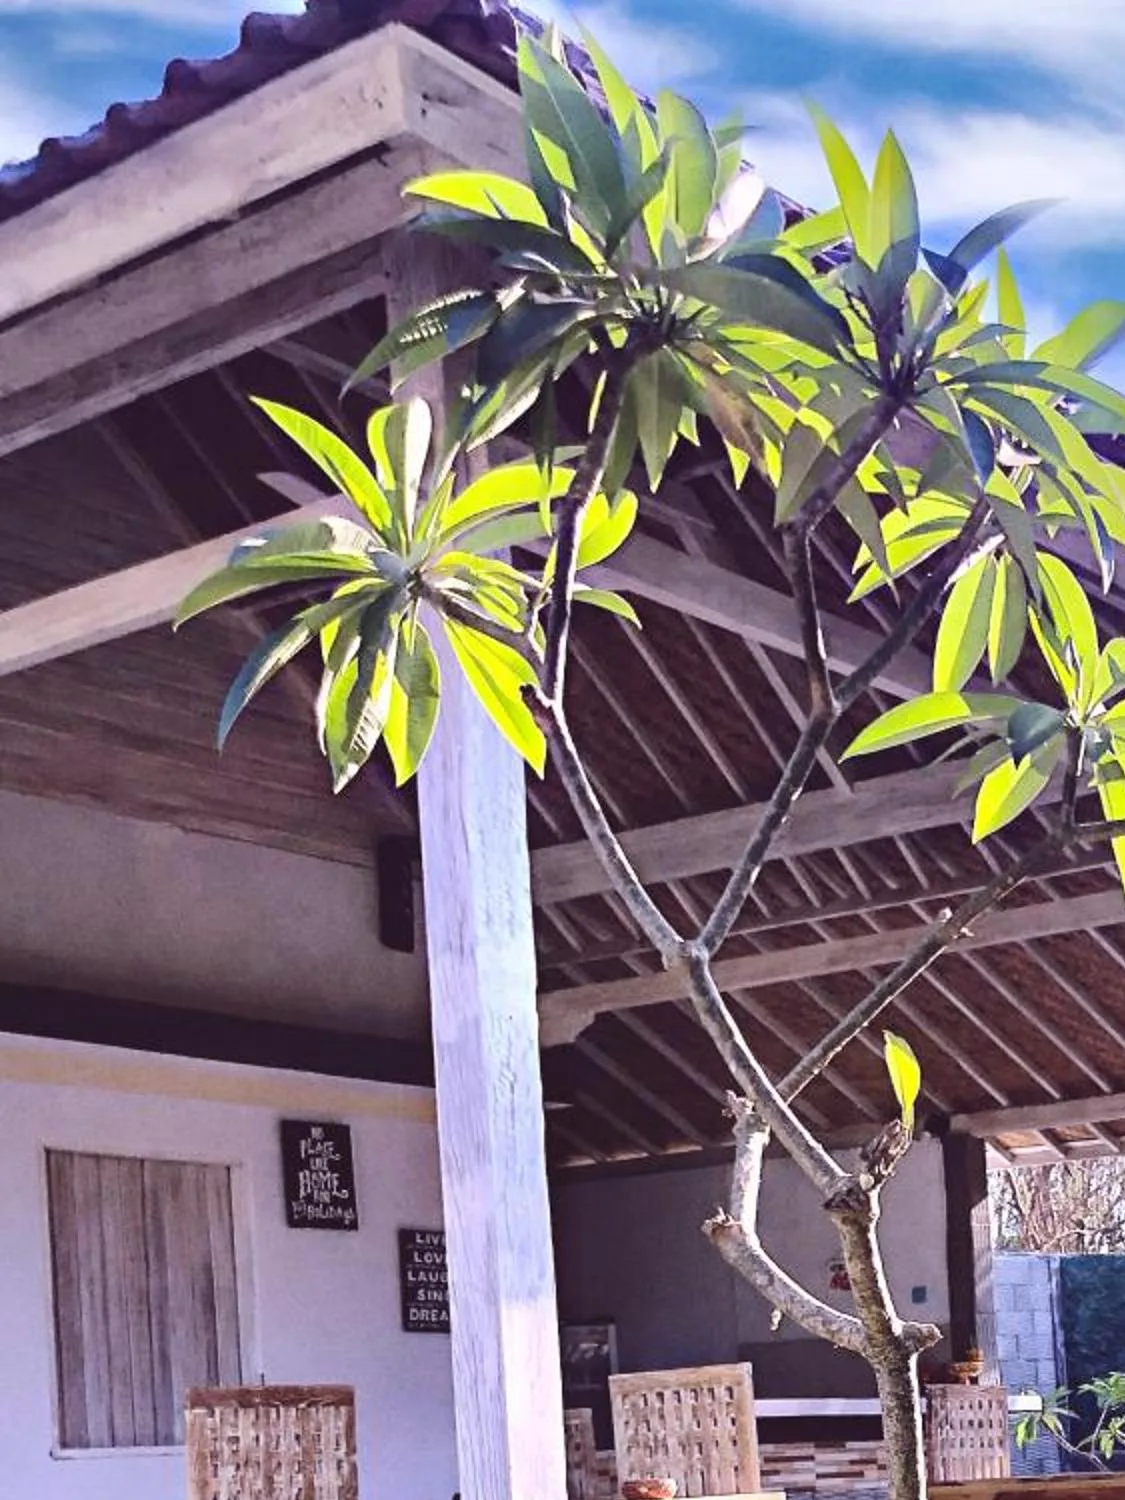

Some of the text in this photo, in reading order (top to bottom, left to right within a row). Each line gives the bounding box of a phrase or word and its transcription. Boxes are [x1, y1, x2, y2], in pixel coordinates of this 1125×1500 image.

[298, 1168, 349, 1199] HOME
[413, 1251, 444, 1263] LOV
[409, 1307, 449, 1322] DREA
